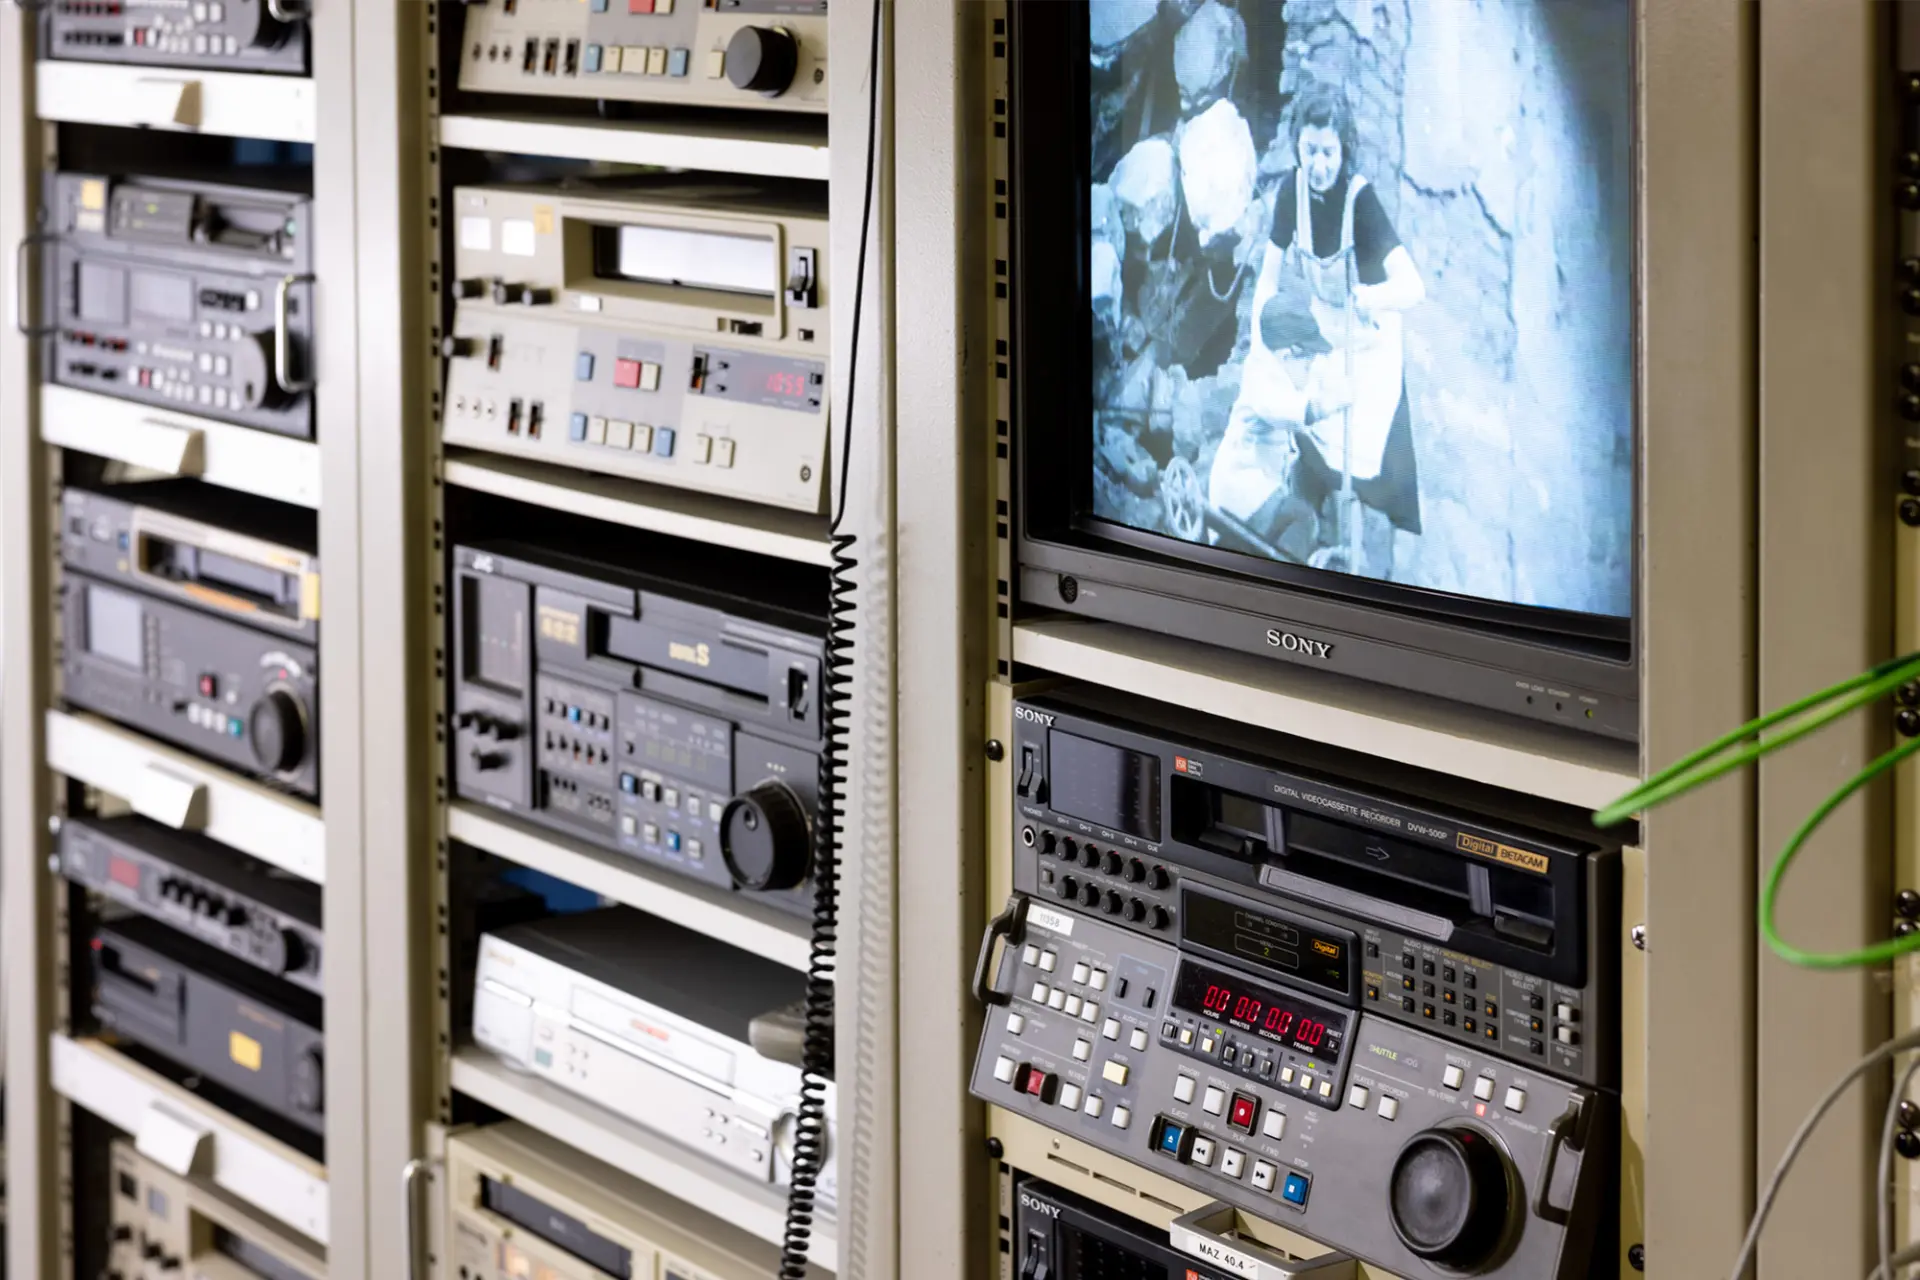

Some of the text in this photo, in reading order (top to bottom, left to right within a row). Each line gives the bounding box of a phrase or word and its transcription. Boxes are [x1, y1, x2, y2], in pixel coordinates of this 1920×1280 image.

[1266, 629, 1332, 659] SONY
[1015, 706, 1055, 726] SONY
[1274, 785, 1448, 839] DIGITAL VIDEOCASSETTE RECORDER DVW-500P
[1462, 836, 1543, 869] Digital BETACAM
[1264, 947, 1270, 956] 2
[1313, 941, 1337, 955] Digital
[1404, 939, 1421, 949] AUDIO
[1204, 985, 1325, 1045] 00 00 00 00
[1203, 1009, 1314, 1054] HOURS MINUTES SECONDS FRAMES
[1326, 1028, 1342, 1038] RESET
[1369, 1044, 1397, 1061] SHUTTLE
[1445, 1053, 1471, 1068] SHUTTLE
[1481, 1067, 1496, 1077] JOG
[1208, 1076, 1231, 1090] PREROLL
[1353, 1074, 1375, 1088] PLAYER
[1171, 1108, 1188, 1119] EJECT
[1504, 1115, 1538, 1134] FORWARD
[1233, 1132, 1247, 1142] PLAY
[1021, 1194, 1060, 1219] SONY
[1199, 1242, 1244, 1270] MAZ 40.4
